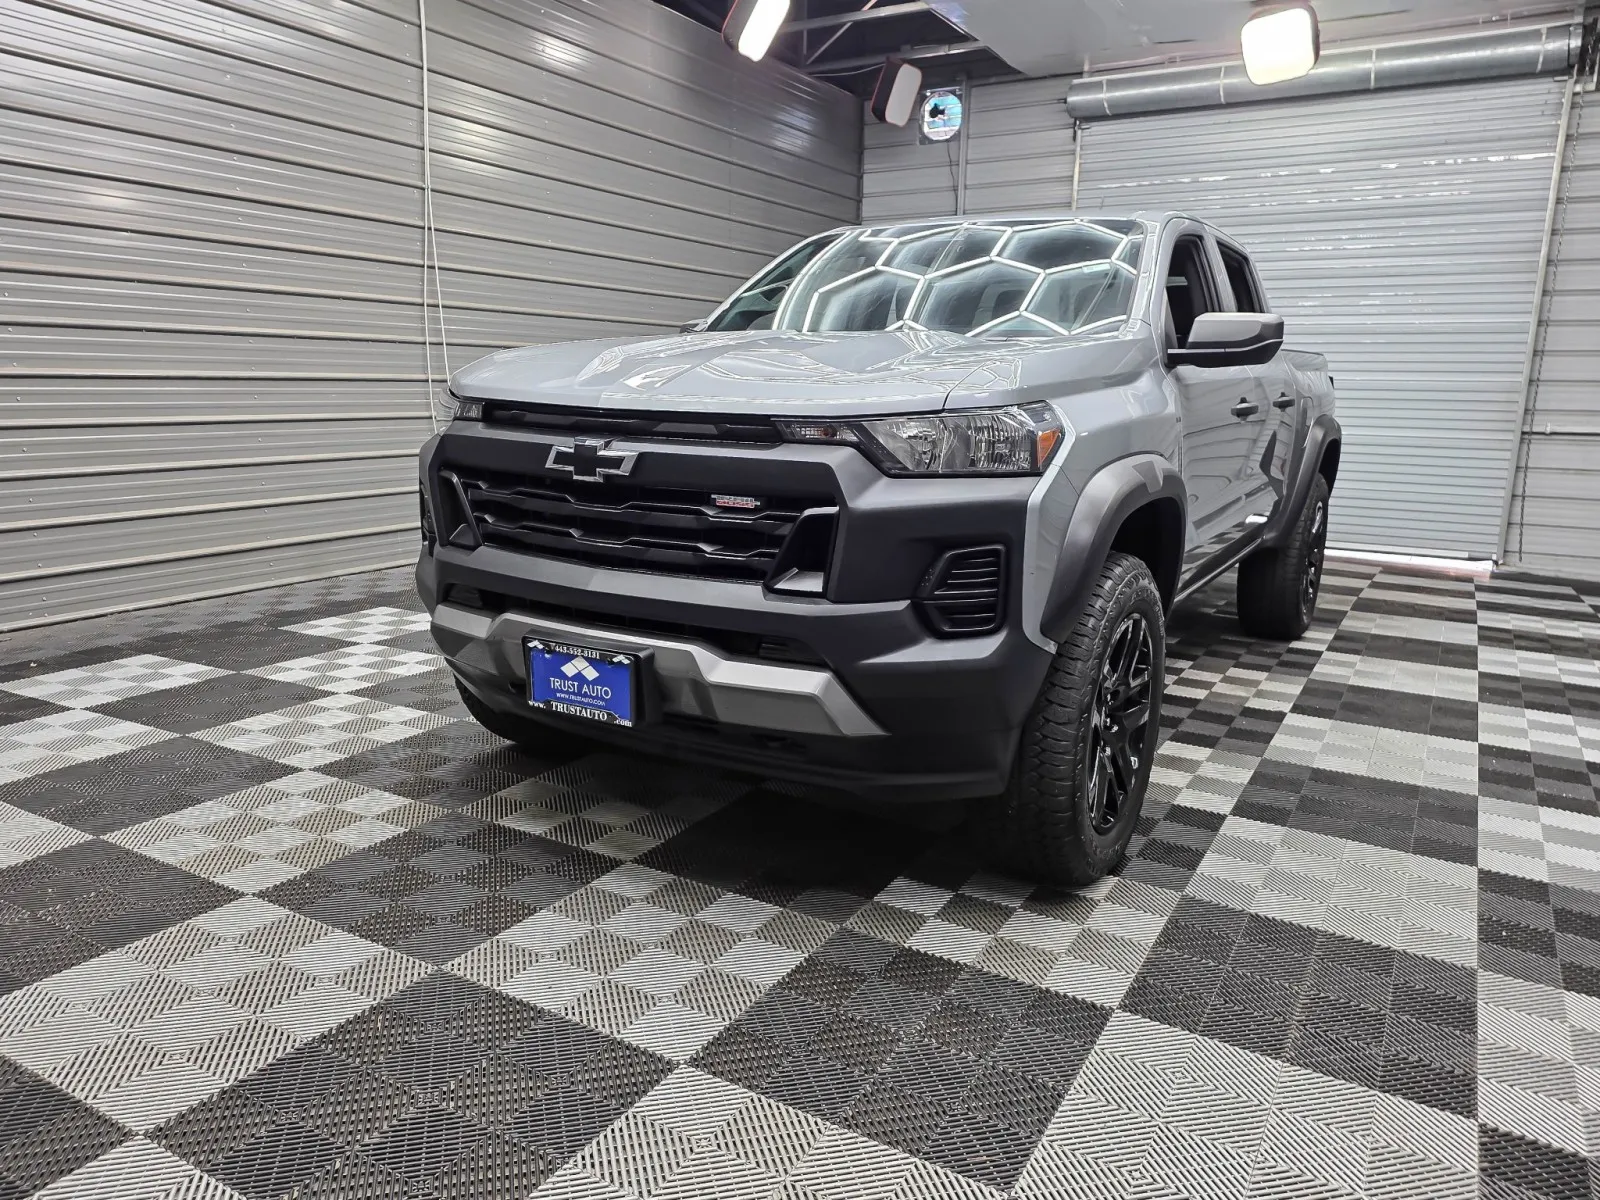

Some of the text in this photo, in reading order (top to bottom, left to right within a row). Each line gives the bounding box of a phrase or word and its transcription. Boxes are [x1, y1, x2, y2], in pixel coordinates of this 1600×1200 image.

[550, 678, 611, 699] TRUST AUTO
[550, 701, 607, 721] TRUSTAUTO
